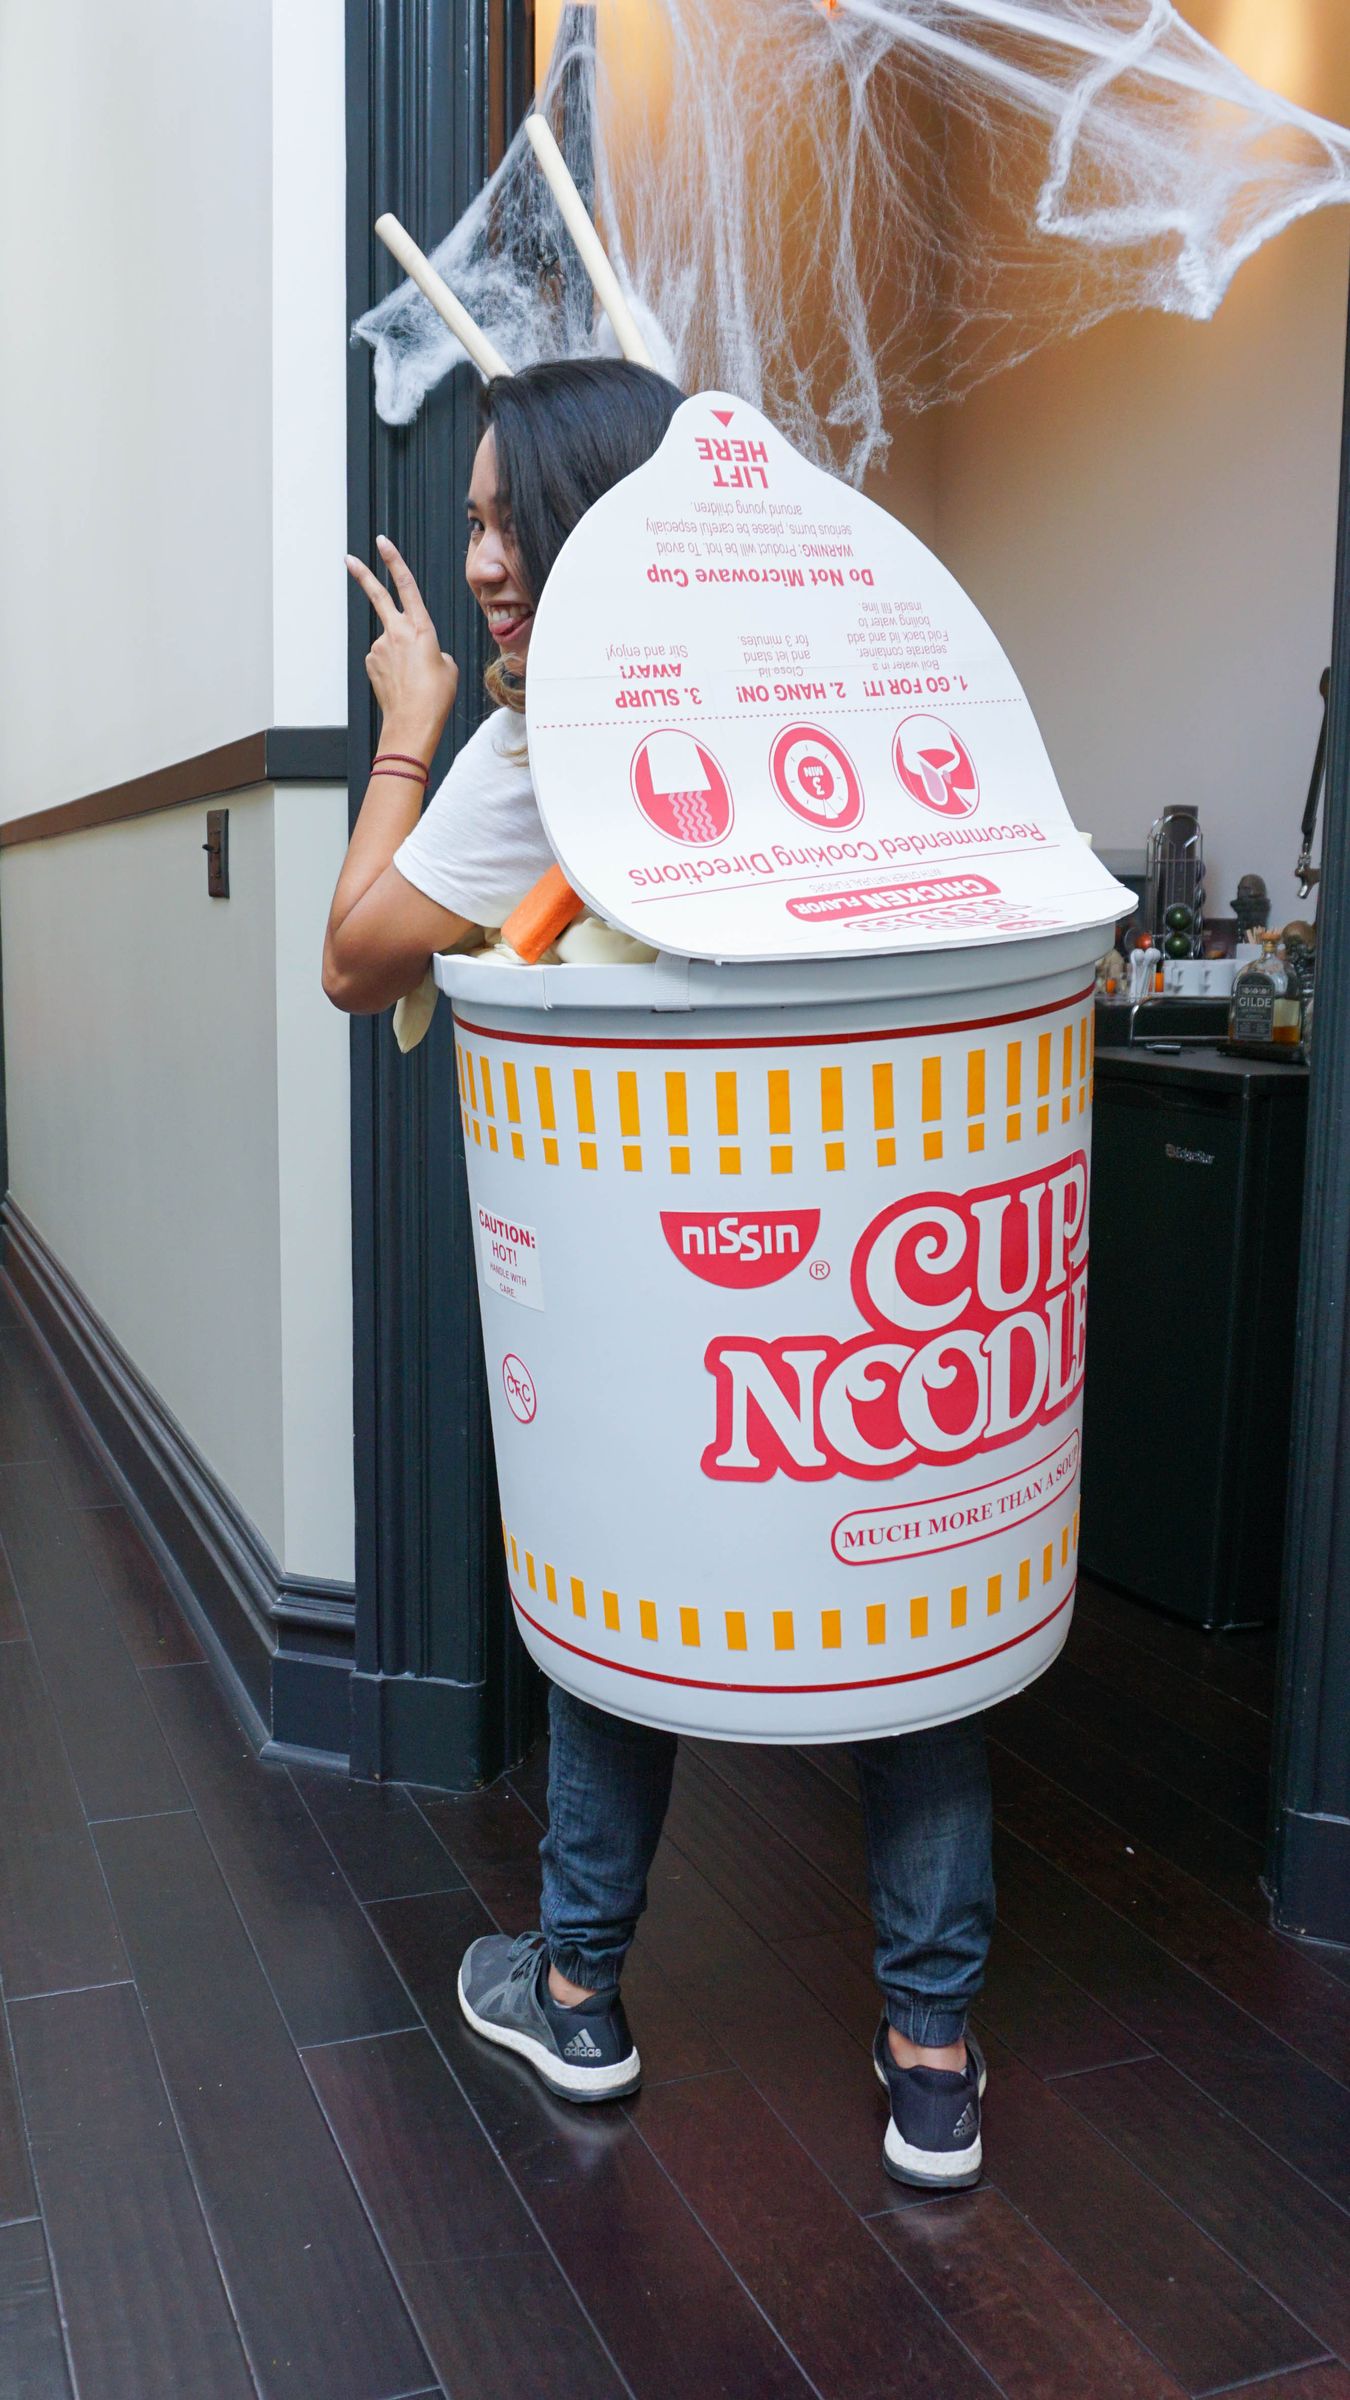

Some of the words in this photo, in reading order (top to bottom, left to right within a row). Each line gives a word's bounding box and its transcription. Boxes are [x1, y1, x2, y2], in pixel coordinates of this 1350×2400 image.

[694, 437, 768, 463] HERE
[713, 465, 768, 489] LIFT
[690, 501, 735, 517] children.
[735, 500, 767, 516] young
[768, 502, 802, 516] around
[646, 518, 698, 537] especially
[699, 522, 735, 537] careful
[736, 523, 750, 537] be
[751, 521, 784, 537] please
[785, 523, 818, 538] burns,
[818, 524, 852, 538] serious
[656, 541, 685, 557] avoid
[687, 542, 702, 557] To
[703, 542, 724, 557] hot.
[724, 543, 738, 557] be
[739, 543, 757, 557] will
[757, 543, 797, 557] Product
[797, 543, 854, 558] WARNING:
[646, 564, 689, 588] Cup
[695, 567, 805, 587] Microwave
[808, 568, 845, 586] Not
[848, 568, 875, 586] Do
[857, 602, 880, 615] line.
[881, 601, 893, 614] fill
[894, 601, 922, 614] inside
[857, 617, 869, 629] to
[869, 616, 897, 627] water
[898, 614, 930, 628] boiling
[737, 634, 783, 648] minutes.
[784, 634, 791, 647] 3
[795, 634, 810, 648] for
[847, 632, 866, 645] add
[867, 631, 887, 644] and
[889, 631, 901, 644] lid
[904, 631, 925, 643] back
[927, 630, 949, 642] Fold
[605, 643, 641, 661] enjoy!
[643, 645, 666, 659] and
[668, 644, 689, 659] Stir
[775, 651, 788, 663] let
[790, 650, 811, 662] and
[856, 646, 904, 659] container.
[906, 642, 948, 657] separate
[743, 652, 773, 665] stand
[892, 660, 918, 671] water
[921, 659, 940, 671] Boil
[619, 663, 682, 680] AWAY!
[758, 667, 771, 679] lid
[773, 665, 804, 678] Close
[881, 662, 891, 672] in
[829, 681, 847, 699] 2.
[862, 680, 886, 697] IT!
[887, 677, 923, 696] FOR
[926, 675, 951, 694] GO
[953, 674, 968, 692] 1.
[614, 688, 681, 709] SLURP
[683, 687, 703, 706] 3.
[735, 684, 770, 704] ON!
[773, 682, 827, 702] HANG
[803, 765, 824, 778] MIN
[812, 776, 825, 796] 3
[879, 821, 1047, 860] Recommended
[771, 841, 879, 872] Cooking
[628, 852, 775, 887] Directions
[861, 878, 984, 911] CHICKEN
[792, 894, 862, 916] FLAVOR
[1239, 997, 1272, 1008] GILDE
[478, 1209, 536, 1249] CAUTION:
[492, 1239, 518, 1267] HOT!
[862, 1160, 1089, 1333] CUP
[490, 1261, 510, 1281] HANDLE
[511, 1271, 527, 1287] WITH
[499, 1282, 516, 1299] CARE.
[842, 1521, 922, 1549] MUCH
[928, 1502, 994, 1536] MORE
[996, 1478, 1044, 1515] THAN
[1045, 1472, 1054, 1490] A
[564, 2046, 602, 2058] adidas
